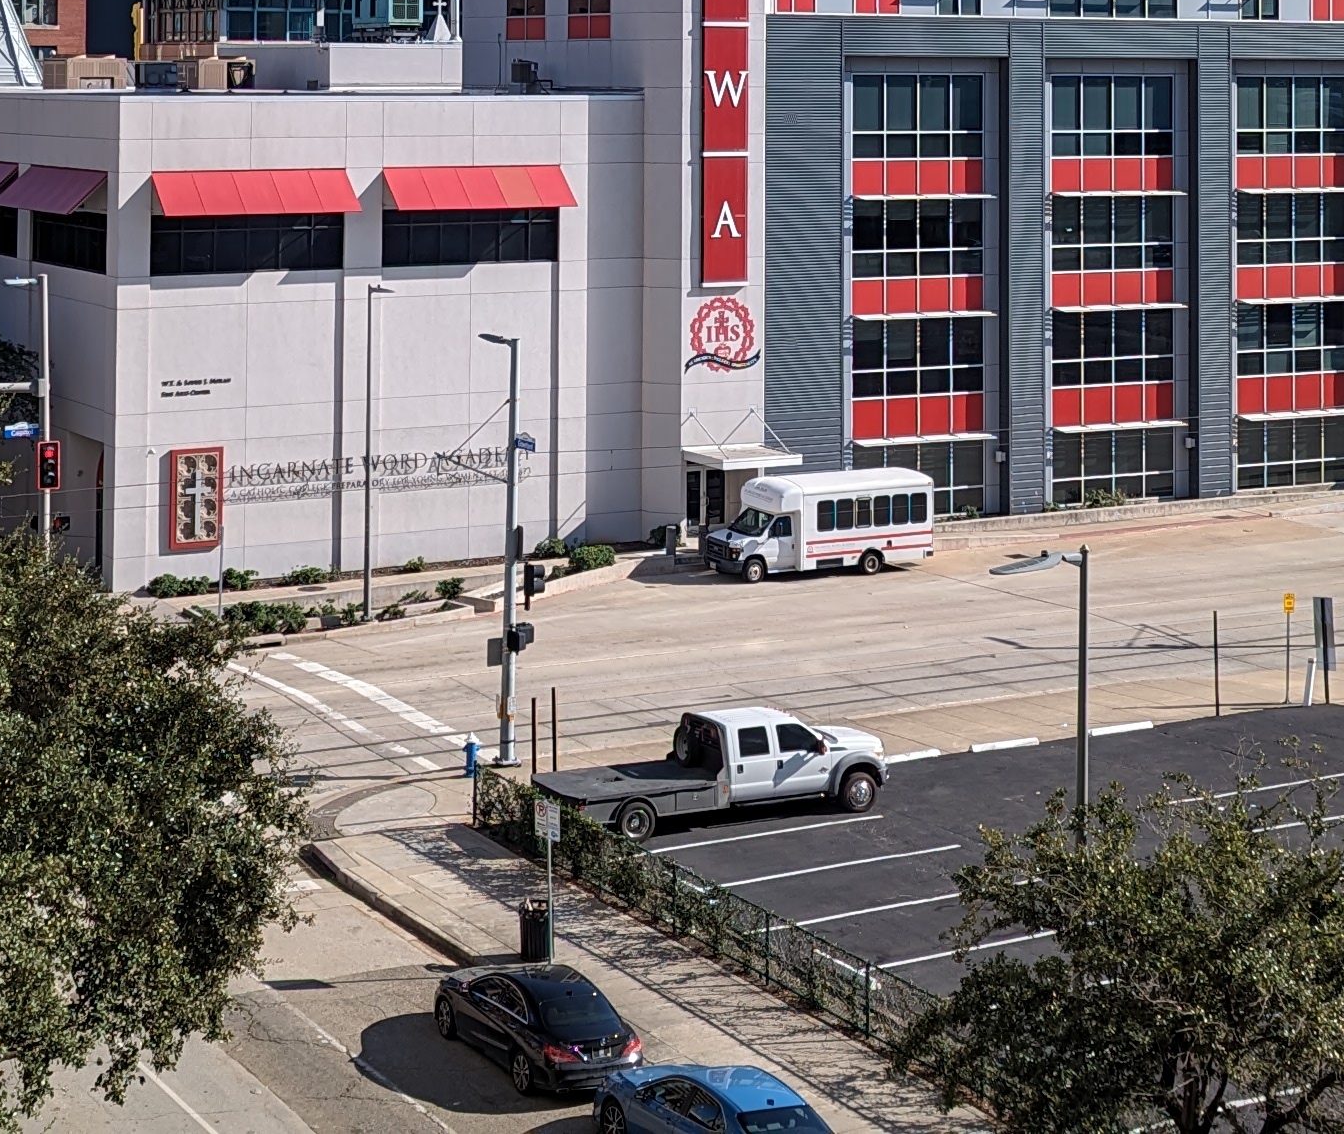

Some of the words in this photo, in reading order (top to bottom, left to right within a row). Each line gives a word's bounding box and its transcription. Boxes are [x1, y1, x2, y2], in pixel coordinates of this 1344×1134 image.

[231, 457, 353, 482] INCARNATE
[360, 452, 427, 473] WORD
[332, 478, 389, 490] PREPARAORY
